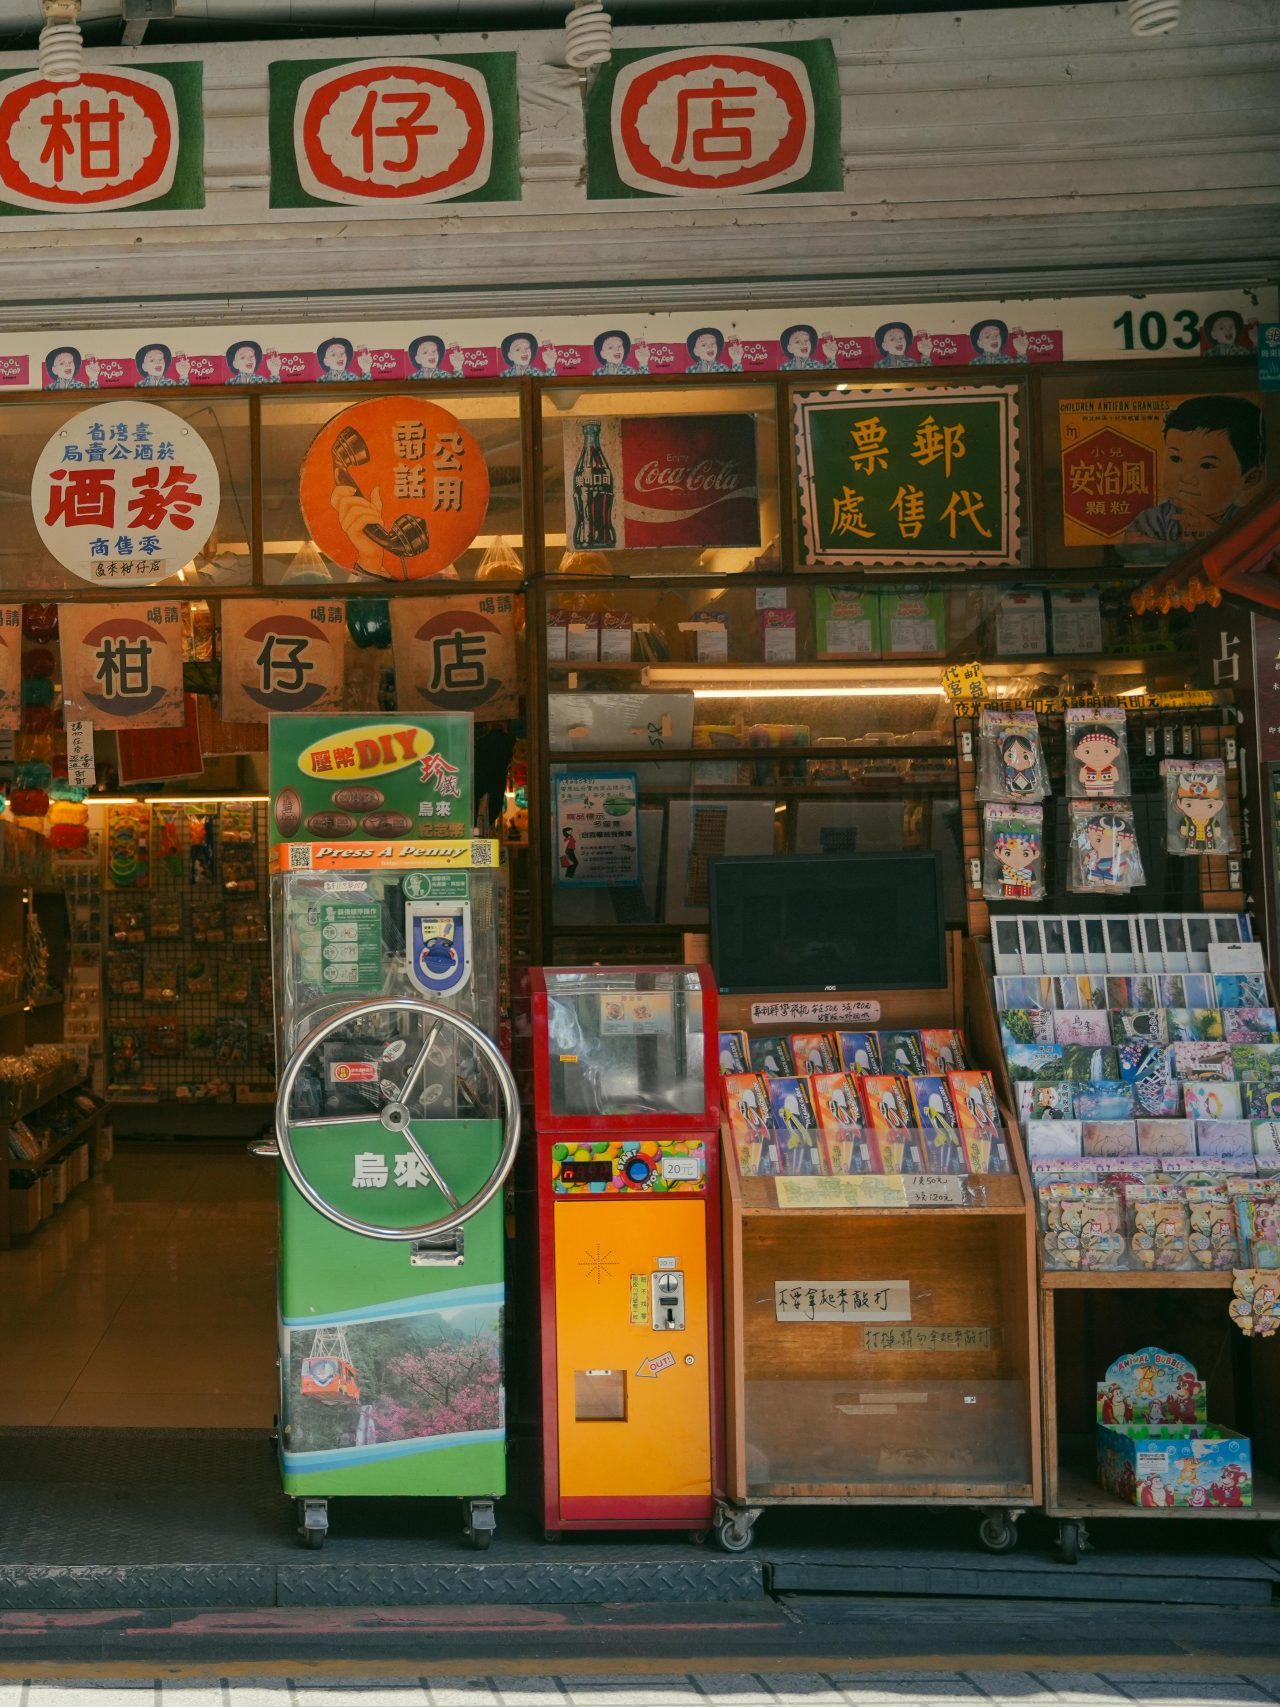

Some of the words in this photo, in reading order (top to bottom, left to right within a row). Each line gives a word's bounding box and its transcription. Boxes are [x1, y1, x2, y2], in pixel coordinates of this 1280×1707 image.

[39, 98, 126, 182] 柑
[351, 90, 438, 173] 仔
[671, 77, 758, 165] 店
[1113, 309, 1201, 351] 103
[61, 442, 176, 464] 菸酒公賣局
[392, 420, 427, 500] 電話
[849, 415, 967, 480] 郵票
[432, 431, 466, 513] 公用
[1069, 460, 1150, 496] 安治風
[44, 465, 203, 531] 菸酒
[830, 484, 993, 539] 代售處
[89, 535, 162, 557] 零售商
[96, 639, 152, 695] 柑
[256, 635, 314, 691] 仔
[430, 632, 487, 689] 店
[419, 753, 461, 797] 珍藏
[419, 801, 452, 817] 烏來
[314, 847, 376, 858] Press
[377, 846, 393, 857] A
[399, 846, 468, 858] Penny
[352, 1152, 431, 1188] 烏來
[617, 1149, 638, 1170] START
[641, 1169, 659, 1191] STOP
[649, 1356, 672, 1373] OUT!
[1118, 1354, 1150, 1371] ANIMAL
[1155, 1354, 1188, 1371] BUBBLE
